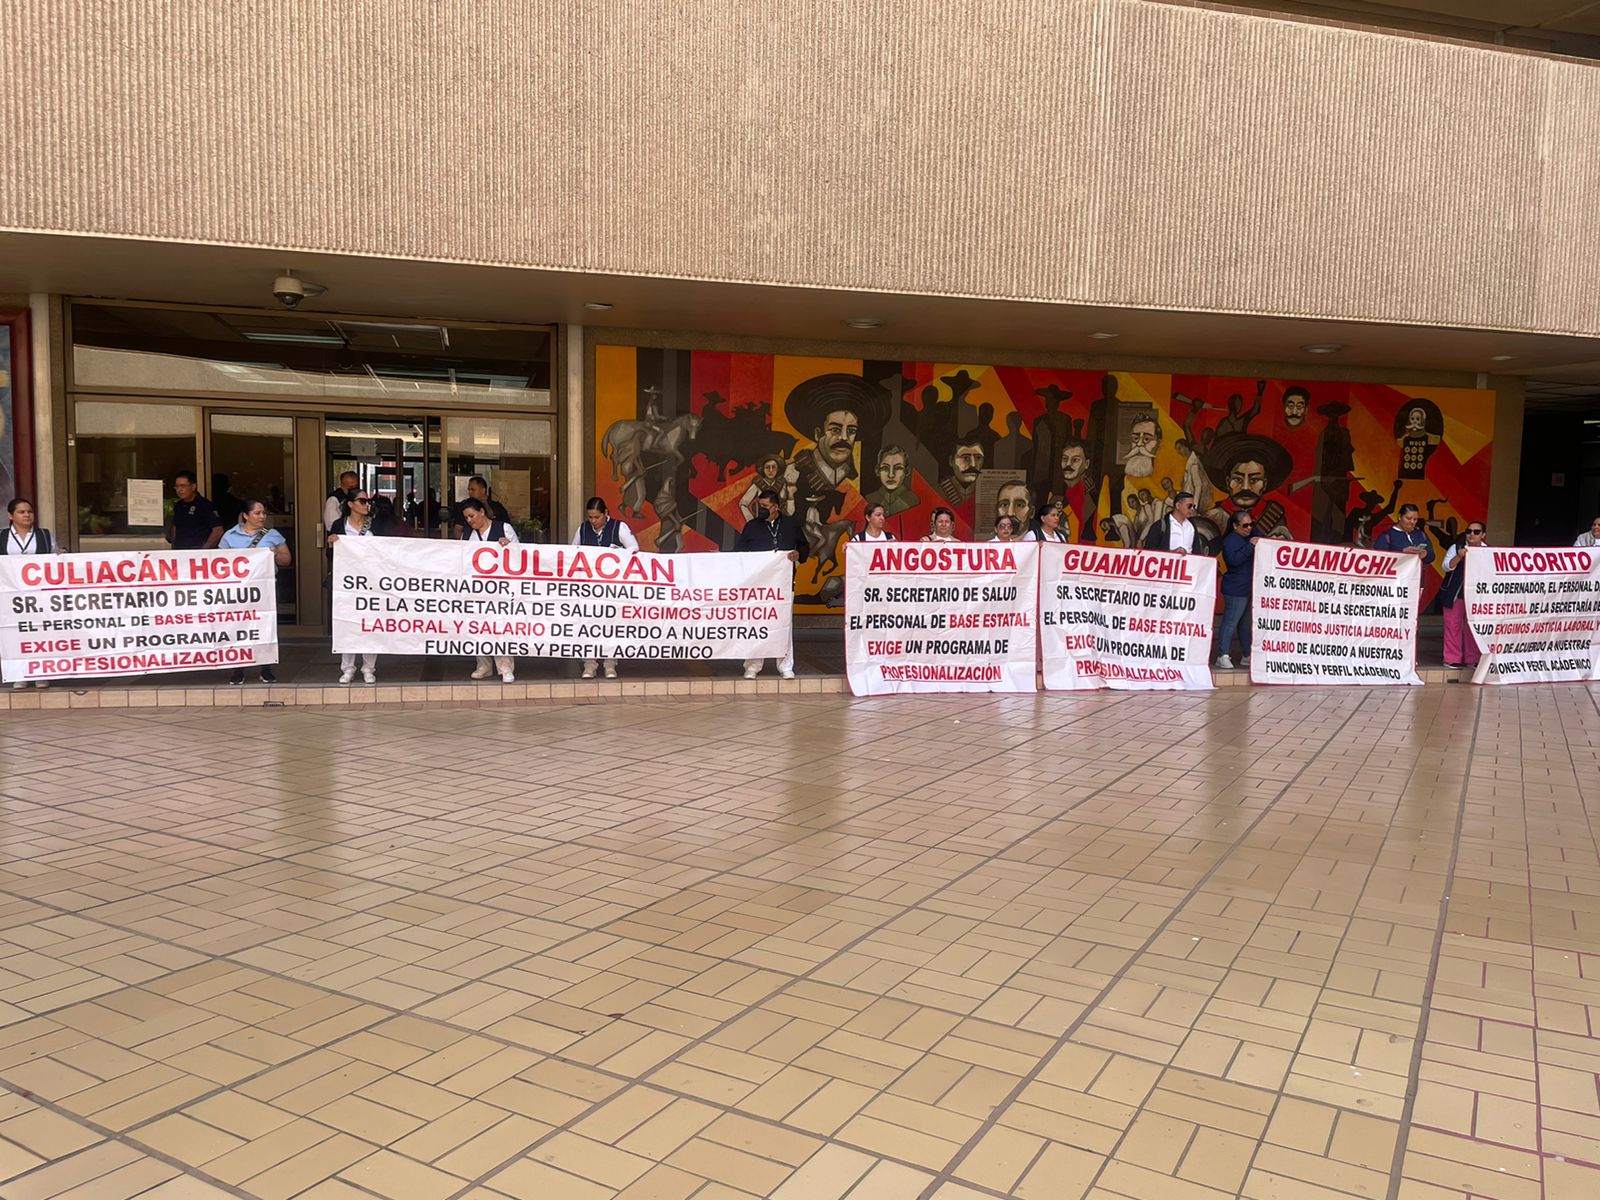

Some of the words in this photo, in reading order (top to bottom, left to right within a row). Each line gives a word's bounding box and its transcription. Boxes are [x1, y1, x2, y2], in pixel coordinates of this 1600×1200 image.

[21, 554, 179, 586] CULIACÁN
[189, 556, 250, 581] HGC
[472, 547, 675, 583] CULIACÁN
[869, 548, 1017, 571] ANGOSTURA
[1064, 549, 1193, 581] GUAMÚCHIL
[1276, 545, 1399, 576] GUAMÚCHIL
[1493, 551, 1592, 572] MOCORITO
[343, 575, 373, 590] SR.
[379, 577, 515, 597] GOBERNADOR,
[520, 582, 541, 596] EL
[546, 582, 639, 600] PERSONAL
[644, 586, 666, 600] DE
[671, 588, 714, 601] BASE
[718, 587, 785, 600] ESTATAL
[864, 587, 882, 602] SR.
[886, 587, 959, 602] SECRETARIO
[963, 587, 978, 601] DE
[982, 586, 1017, 602] SALUD
[1056, 585, 1072, 600] SR.
[1075, 586, 1140, 606] SECRETARIO
[1144, 593, 1157, 608] DE
[1159, 595, 1196, 611] SALUD
[1264, 576, 1276, 588] SR.
[1279, 578, 1336, 596] GOBERNADOR,
[1338, 582, 1348, 595] EL
[1350, 583, 1394, 598] PERSONAL
[1397, 586, 1408, 598] DE
[1476, 582, 1489, 594] SR.
[1492, 582, 1546, 595] GOBERNADOR,
[1548, 582, 1557, 593] EL
[1558, 581, 1592, 593] PERSONAL
[1594, 581, 1600, 591] D
[12, 596, 43, 614] SR.
[50, 590, 168, 612] SECRETARIO
[175, 589, 197, 606] DE
[203, 586, 261, 604] SALUD
[355, 597, 380, 611] DE
[385, 598, 408, 612] LA
[414, 597, 527, 616] SECRETARÍA
[532, 602, 555, 616] DE
[560, 603, 617, 618] SALUD
[622, 606, 702, 620] EXIGIMOS
[705, 607, 778, 620] JUSTICIA
[1261, 597, 1280, 610] BASE
[1282, 599, 1316, 613] ESTATAL
[1318, 602, 1329, 614] DE
[1331, 603, 1341, 615] LA
[1344, 603, 1396, 619] SECRETARÍA
[1399, 607, 1409, 619] DE
[1472, 603, 1493, 615] BASE
[1496, 603, 1527, 615] ESTATAL
[1529, 603, 1539, 614] DE
[1540, 603, 1549, 614] LA
[1550, 598, 1592, 613] SECRETARÍA
[18, 620, 34, 632] EL
[42, 617, 126, 631] PERSONAL
[131, 615, 150, 626] DE
[154, 614, 193, 626] BASE
[198, 610, 261, 623] ESTATAL
[361, 618, 448, 634] LABORAL
[453, 620, 464, 634] Y
[468, 621, 545, 636] SALARIO
[551, 624, 573, 637] DE
[578, 624, 662, 639] ACUERDO
[666, 626, 678, 639] A
[682, 626, 769, 640] NUESTRAS
[850, 616, 862, 630] EL
[866, 614, 927, 629] PERSONAL
[931, 614, 946, 629] DE
[950, 614, 979, 628] BASE
[982, 612, 1030, 627] ESTATAL
[1044, 612, 1056, 625] EL
[1060, 612, 1109, 629] PERSONAL
[1112, 616, 1126, 630] DE
[1129, 617, 1157, 633] BASE
[1159, 620, 1207, 638] ESTATAL
[1258, 618, 1281, 631] SALUD
[1283, 620, 1322, 634] EXIGIMOS
[1324, 623, 1362, 637] JUSTICIA
[1364, 626, 1403, 639] LABORAL
[1404, 628, 1410, 640] Y
[1495, 622, 1530, 635] EXIGIMOS
[1531, 621, 1562, 634] JUSTICIA
[1563, 620, 1593, 632] LABORAL
[20, 639, 81, 654] EXIGE
[88, 637, 116, 650] UN
[123, 631, 230, 648] PROGRAMA
[236, 629, 260, 641] DE
[425, 640, 529, 656] FUNCIONES
[534, 644, 544, 656] Y
[549, 643, 608, 658] PERFIL
[613, 645, 713, 659] ACADEMICO
[868, 641, 902, 655] EXIGE
[905, 640, 922, 654] UN
[926, 639, 991, 655] PROGRAMA
[994, 639, 1008, 654] DE
[1066, 635, 1096, 650] EXIGE
[1096, 637, 1110, 652] UN
[1111, 640, 1167, 660] PROGRAMA
[1171, 647, 1185, 661] DE
[1262, 639, 1295, 653] SALARIO
[1297, 642, 1307, 654] DE
[1309, 643, 1348, 657] ACUERDO
[1350, 646, 1356, 657] A
[1358, 646, 1403, 660] NUESTRAS
[1503, 643, 1513, 654] DE
[1513, 641, 1545, 653] ACUERDO
[1546, 641, 1554, 650] A
[1554, 640, 1591, 651] NUESTRAS
[28, 646, 253, 674] PROFESIONALIZACIÓN
[880, 662, 1002, 680] PROFESIONALIZACIÓN
[1266, 661, 1313, 675] FUNCIONES
[1315, 664, 1320, 675] Y
[1322, 665, 1352, 677] PERFIL
[1518, 660, 1526, 672] Y
[1527, 661, 1550, 672] PERFIL
